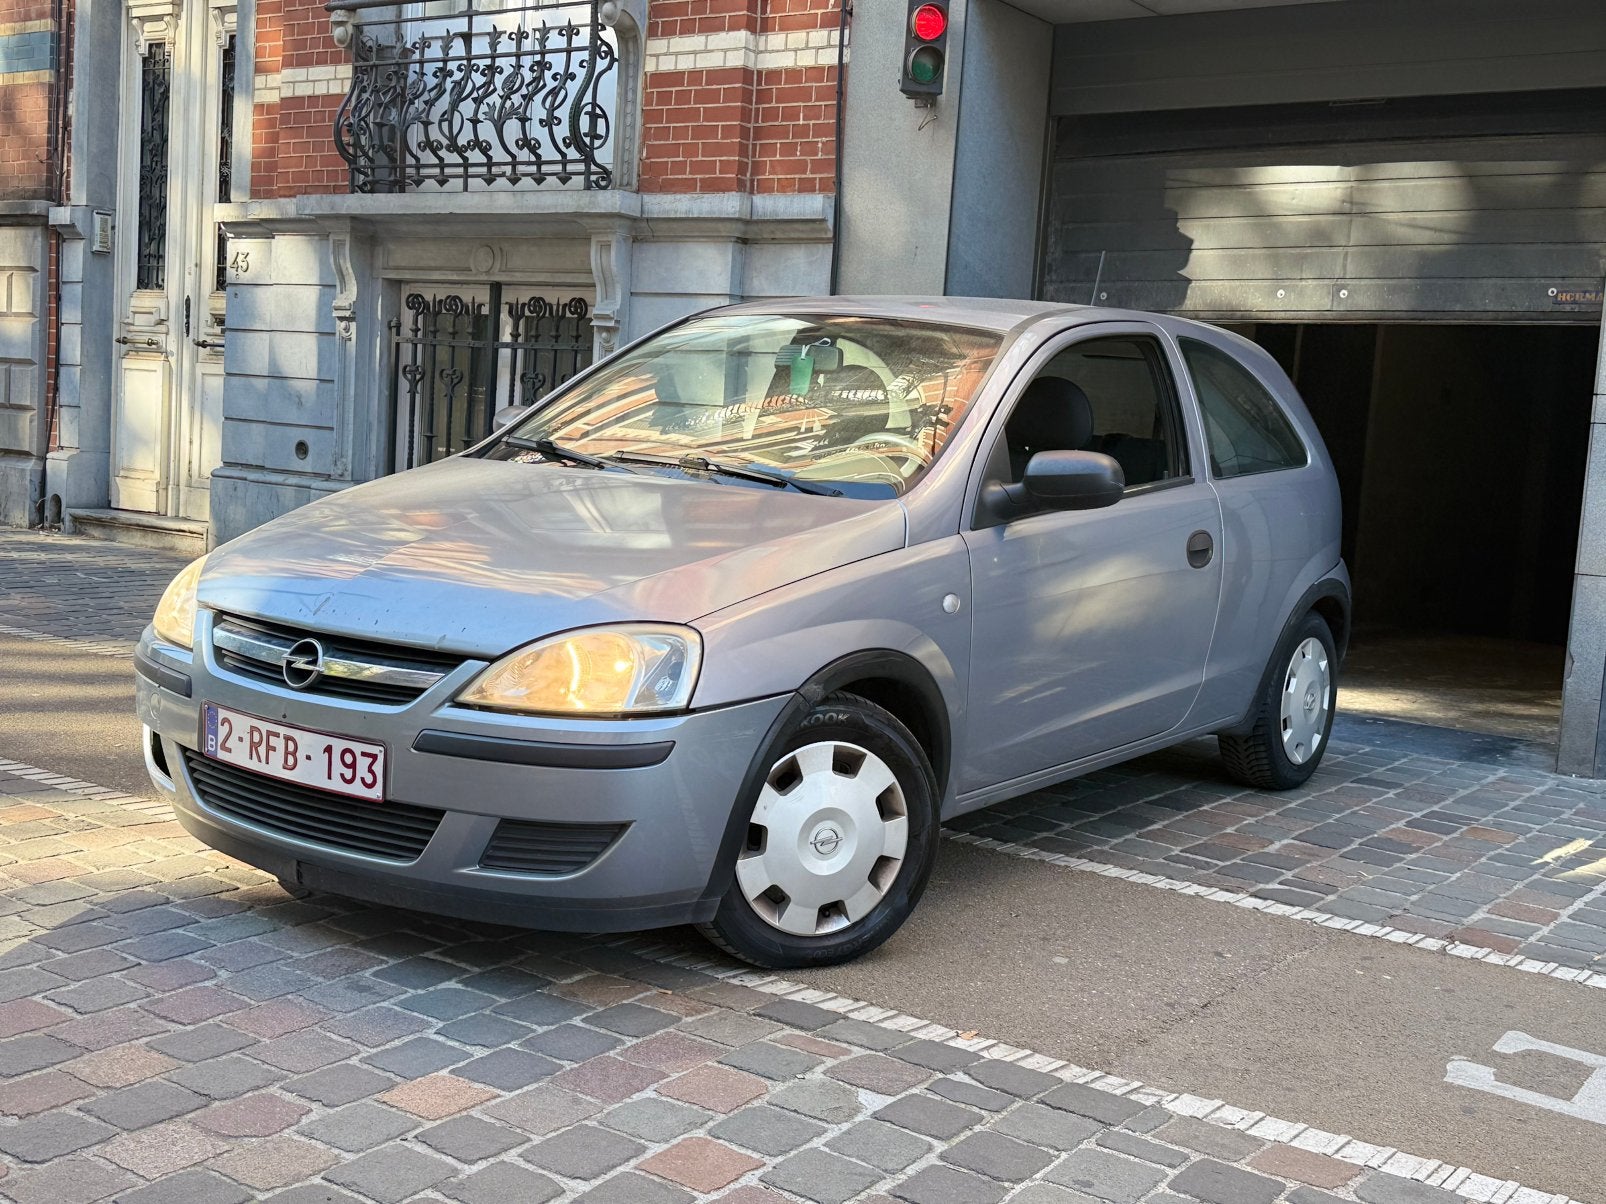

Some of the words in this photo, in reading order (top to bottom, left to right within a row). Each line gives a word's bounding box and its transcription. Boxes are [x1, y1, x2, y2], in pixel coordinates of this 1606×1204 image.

[229, 251, 250, 273] 43
[207, 734, 216, 752] B
[219, 716, 379, 790] 2-RFB-193
